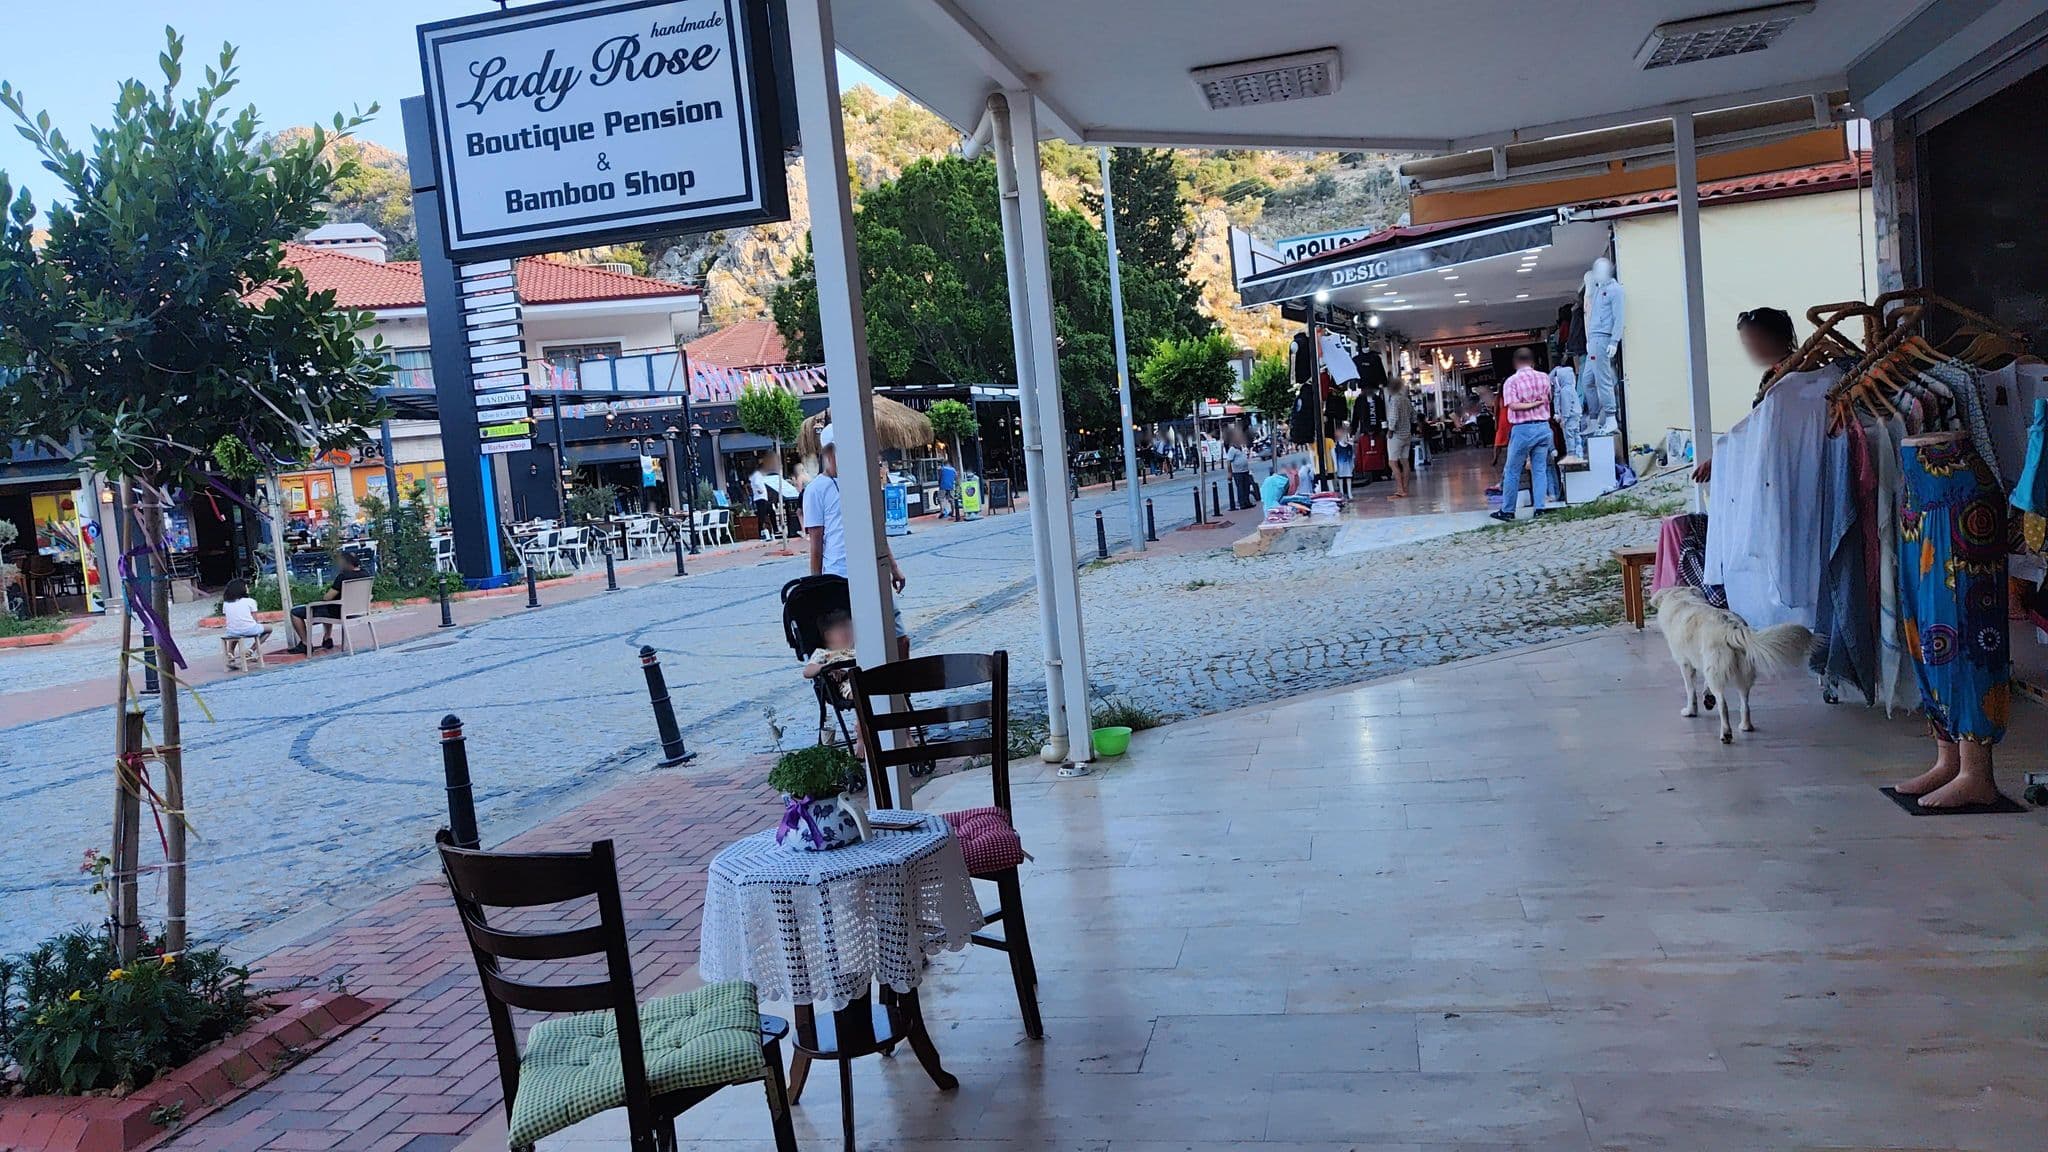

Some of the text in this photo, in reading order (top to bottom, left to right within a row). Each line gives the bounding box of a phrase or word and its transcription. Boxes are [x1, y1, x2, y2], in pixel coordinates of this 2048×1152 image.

[651, 11, 724, 38] handmade
[456, 34, 721, 115] Lady Rose
[466, 100, 723, 157] Boutique Pension
[597, 152, 611, 171] &
[505, 169, 696, 214] Bamboo Shop
[1286, 237, 1357, 261] APOLLO
